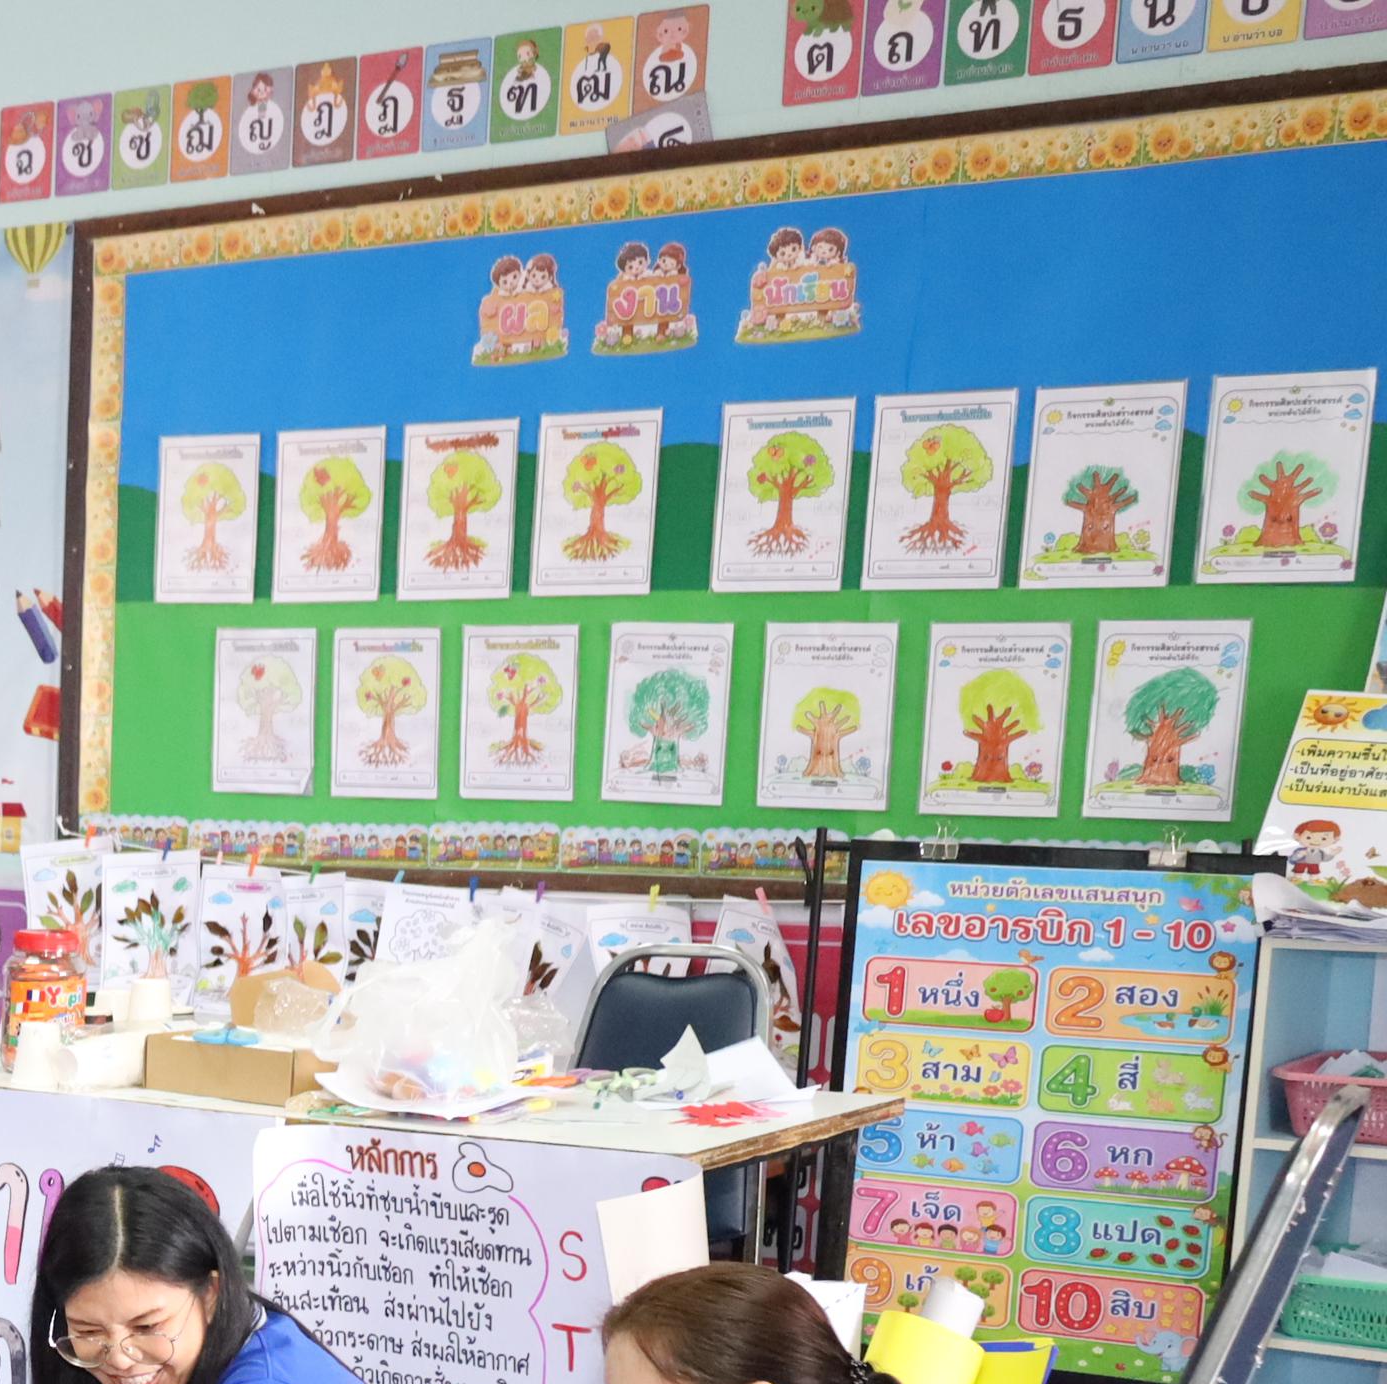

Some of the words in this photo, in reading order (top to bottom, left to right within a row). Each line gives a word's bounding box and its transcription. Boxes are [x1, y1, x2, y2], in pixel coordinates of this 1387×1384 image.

[969, 17, 1002, 53] ท
[1057, 7, 1085, 41] ธ
[807, 42, 835, 75] ต
[887, 31, 914, 65] ถ
[649, 62, 687, 96] ณ
[445, 86, 466, 127] ฐ
[249, 118, 273, 151] ญ
[16, 149, 33, 176] ฉ
[948, 878, 1163, 909] หน่วยตัวเลขแสนสนุก
[894, 908, 1092, 947] เลขอารบิก
[1106, 915, 1127, 947] 1
[1165, 918, 1216, 951] 10
[875, 965, 907, 1019] 1
[918, 973, 981, 1009] หนึ่ง
[1055, 974, 1107, 1034] 2
[1115, 983, 1179, 1009] สอง
[865, 1039, 911, 1091] 3
[921, 1059, 982, 1083] สาม
[1045, 1053, 1098, 1109] 4
[1118, 1055, 1141, 1091] สี่
[346, 1138, 439, 1181] หลักการ
[860, 1116, 905, 1167] 5
[917, 1124, 956, 1153] ห้า
[1038, 1131, 1091, 1187] 6
[1108, 1143, 1154, 1168] หก
[854, 1184, 899, 1235] 7
[911, 1192, 962, 1223] เจ็ด
[262, 1214, 368, 1247] ไปตามเชือก
[378, 1222, 533, 1267] จะเกิดแรงเสียดทาน
[1032, 1204, 1083, 1258] 8
[1092, 1219, 1161, 1247] แปด
[268, 1248, 414, 1285] ระหว่างนิ้วกับเชือก
[428, 1258, 513, 1298] ทำให้เชือก
[558, 1230, 588, 1282] S
[849, 1257, 894, 1306] 9
[271, 1283, 370, 1315] สั่นสะเทือน
[383, 1291, 494, 1332] ส่งผ่านไปยัง
[1019, 1275, 1103, 1332] 10
[1109, 1290, 1156, 1321] สิบ
[411, 1331, 530, 1376] ส่งผลให้อากาศ
[552, 1322, 593, 1372] T
